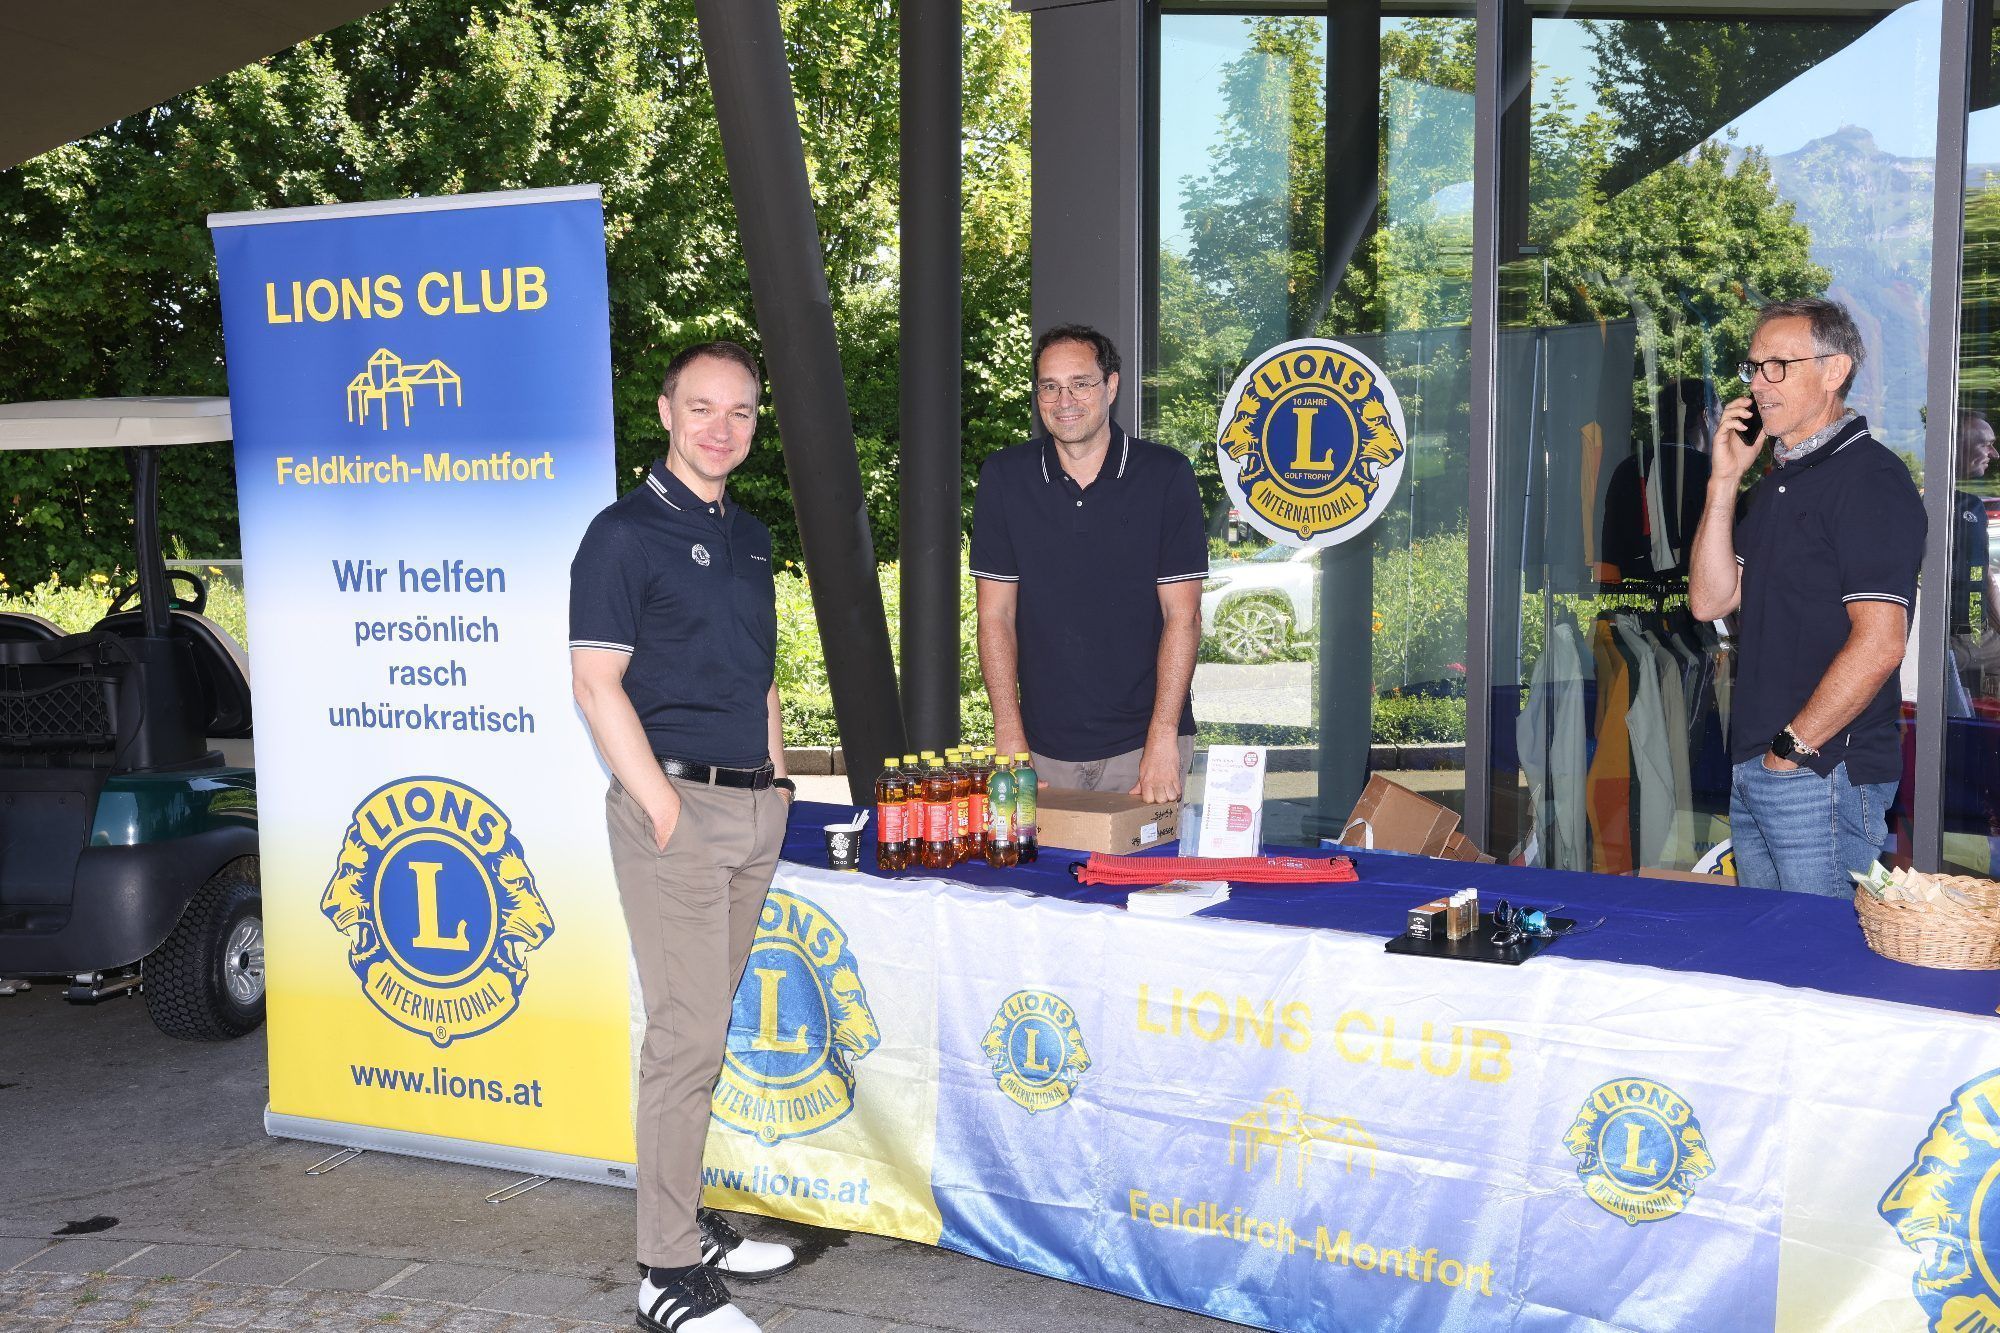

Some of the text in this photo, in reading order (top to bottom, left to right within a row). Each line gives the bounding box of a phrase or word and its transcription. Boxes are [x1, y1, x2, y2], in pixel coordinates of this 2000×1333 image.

[266, 266, 548, 324] LIONS CLUB
[1261, 354, 1365, 395] LIONS
[1293, 398, 1328, 406] 10 JAHRE
[1290, 407, 1335, 471] L
[276, 451, 555, 485] Feldkirch-Montfort
[1284, 472, 1331, 481] GOLF TROPHY
[1257, 487, 1359, 524] INTERNATIONAL
[332, 559, 506, 593] Wir helfen
[355, 616, 499, 646] persönlich
[388, 660, 467, 687] rasch
[328, 703, 535, 734] unbürokratisch
[364, 786, 499, 846] LIONS
[408, 861, 470, 952] L
[757, 898, 835, 959] ONS
[375, 971, 506, 1024] INTERNATIONAL
[751, 968, 809, 1054] L
[1008, 995, 1069, 1024] LIONS
[1024, 1028, 1050, 1071] L
[1137, 983, 1514, 1085] LIONS CLUB
[350, 1064, 542, 1108] www.lions.at
[713, 1077, 842, 1125] NTERNATIONAL
[1004, 1078, 1065, 1104] INTERNATIONAL
[1598, 1083, 1684, 1121] LIONS
[1621, 1122, 1656, 1176] L
[702, 1164, 870, 1206] ww.lions.at
[1592, 1180, 1677, 1214] INTERNATIONAL
[1129, 1188, 1495, 1297] Feldkirch-Montfort
